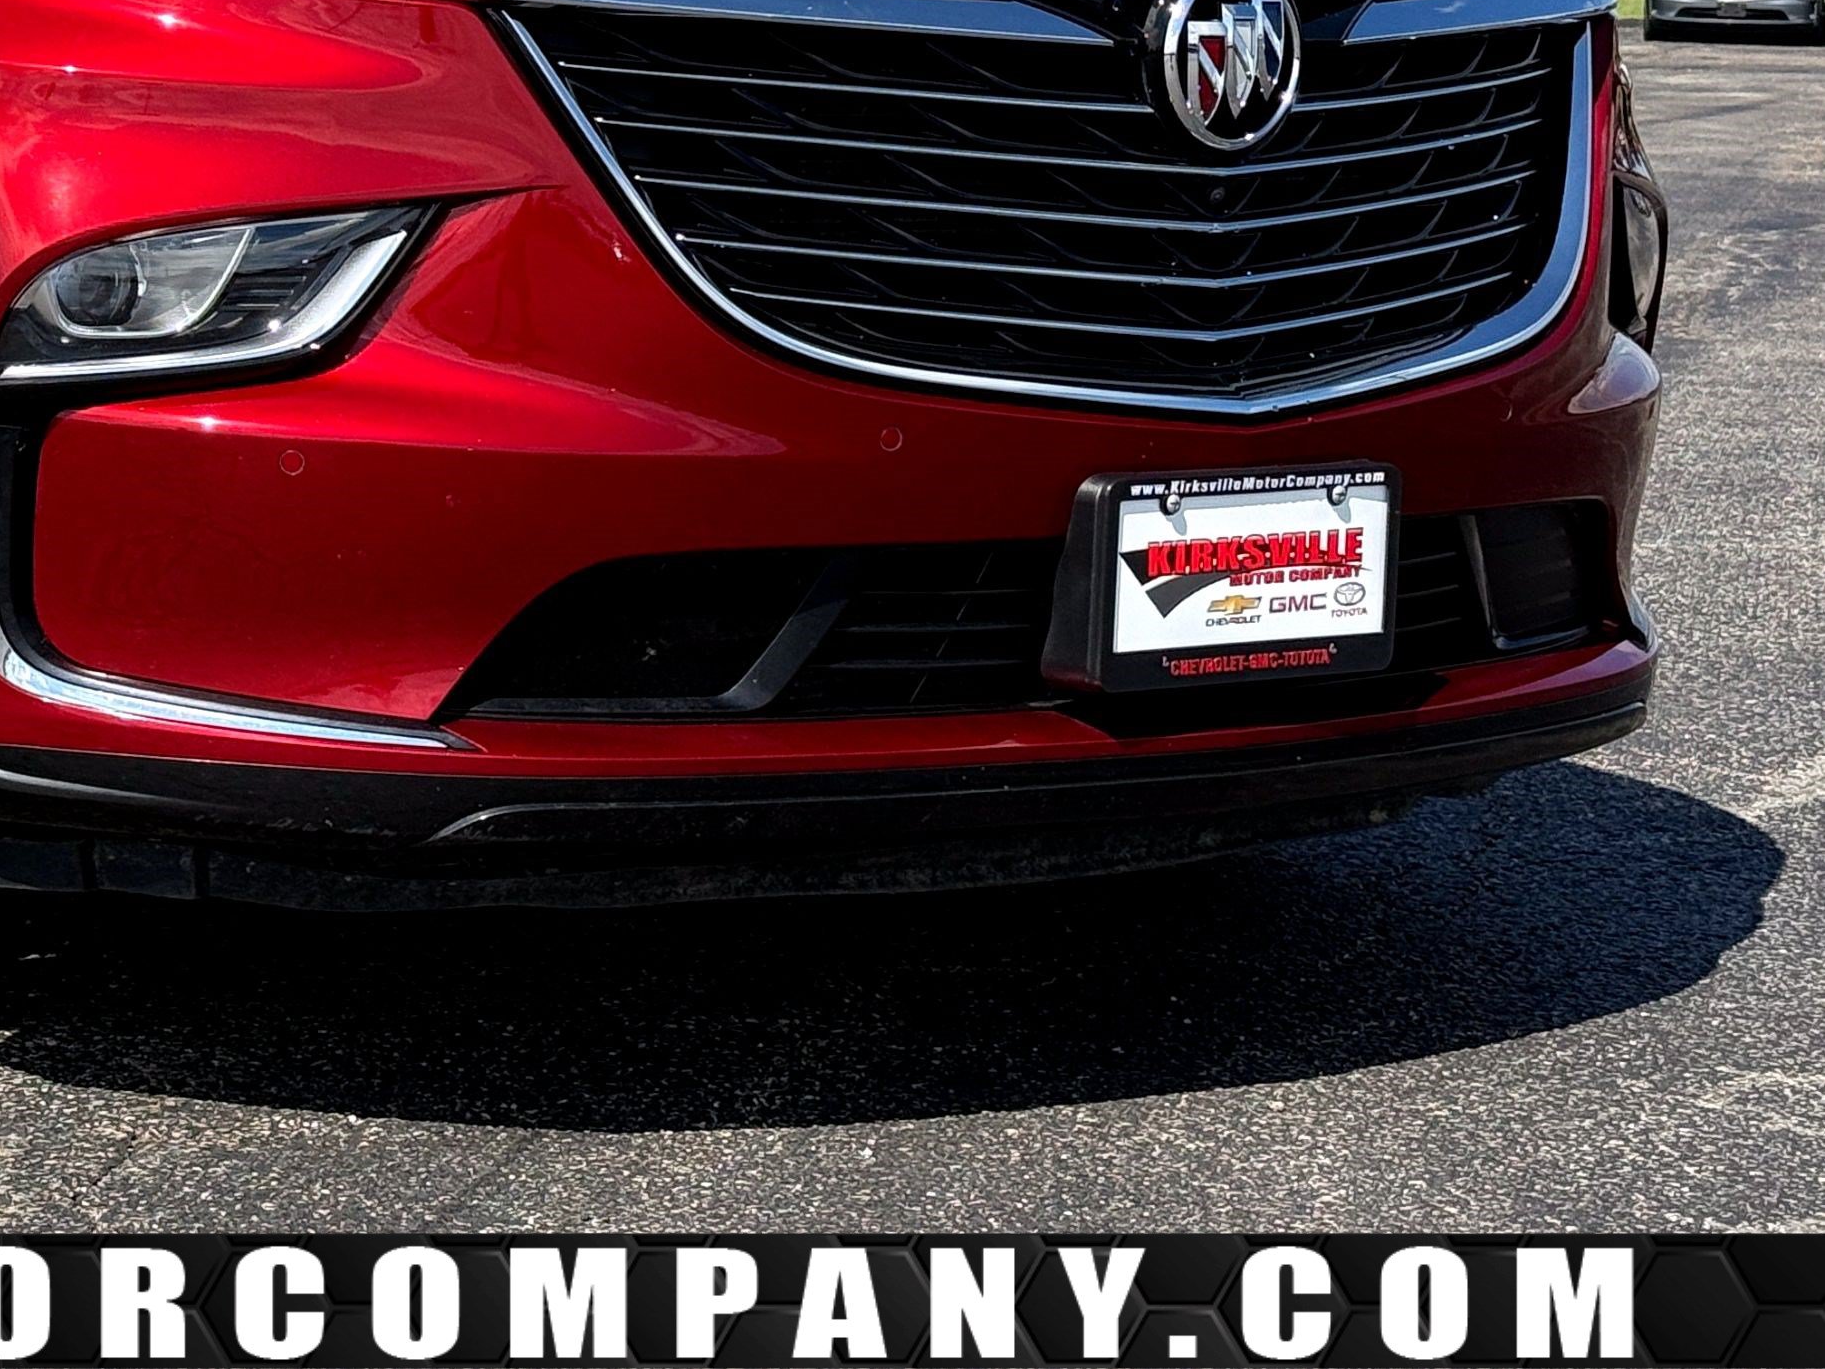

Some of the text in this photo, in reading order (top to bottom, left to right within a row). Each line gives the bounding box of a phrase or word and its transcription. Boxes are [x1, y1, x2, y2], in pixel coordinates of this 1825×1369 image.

[1147, 527, 1364, 577] KIRKSVILLE
[1229, 564, 1362, 587] MOTOR COMPANY
[1269, 592, 1327, 614] GMC
[1331, 607, 1368, 618] TOYOTA
[1205, 614, 1262, 627] CHEVROLET
